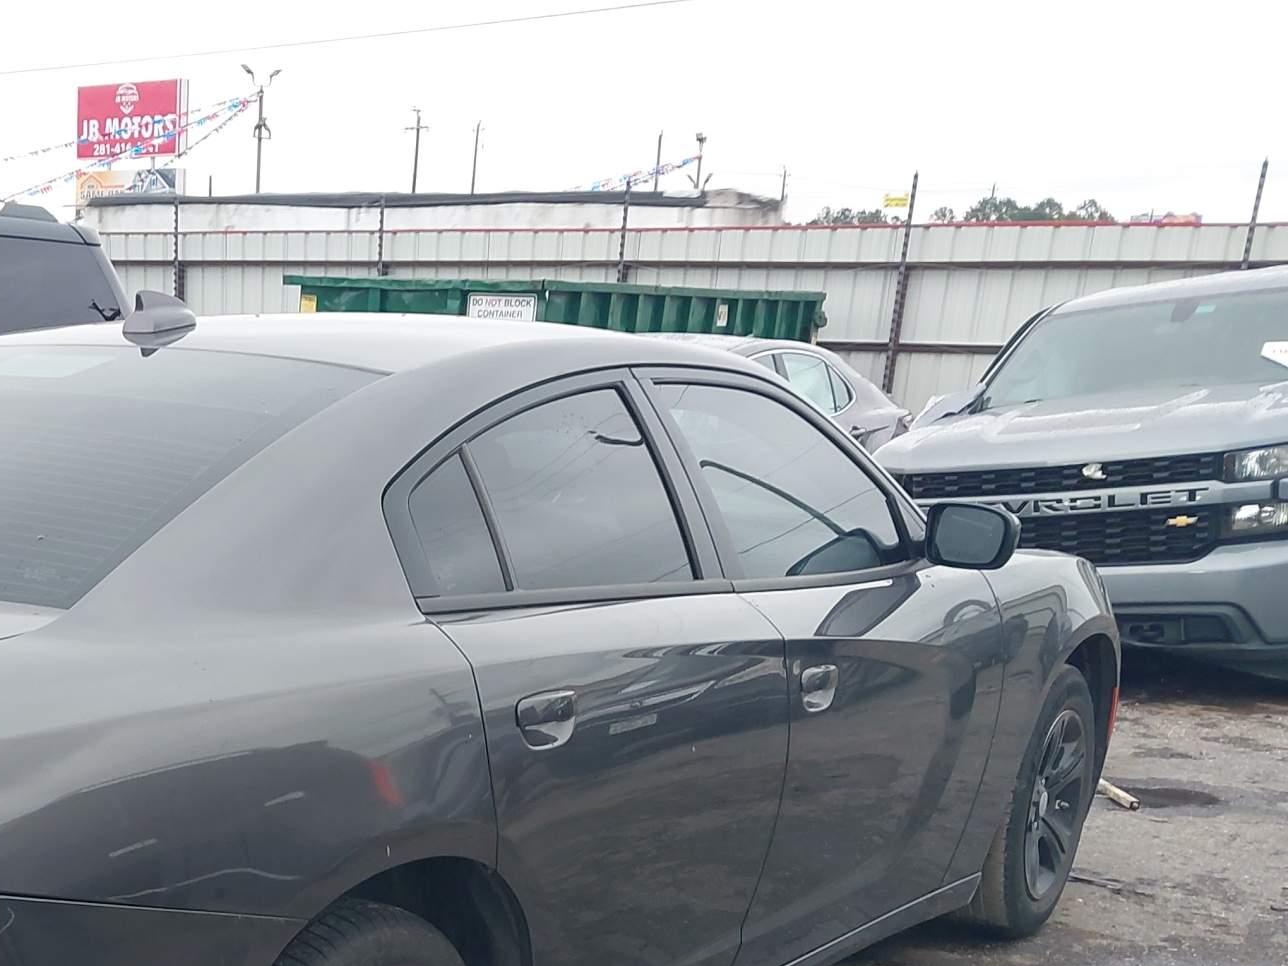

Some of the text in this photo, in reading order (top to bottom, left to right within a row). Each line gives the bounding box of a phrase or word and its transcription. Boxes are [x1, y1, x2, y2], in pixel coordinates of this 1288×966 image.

[105, 114, 175, 140] MOTORS
[472, 298, 532, 308] DO NOT BLOCK
[477, 309, 523, 318] CONTAINER
